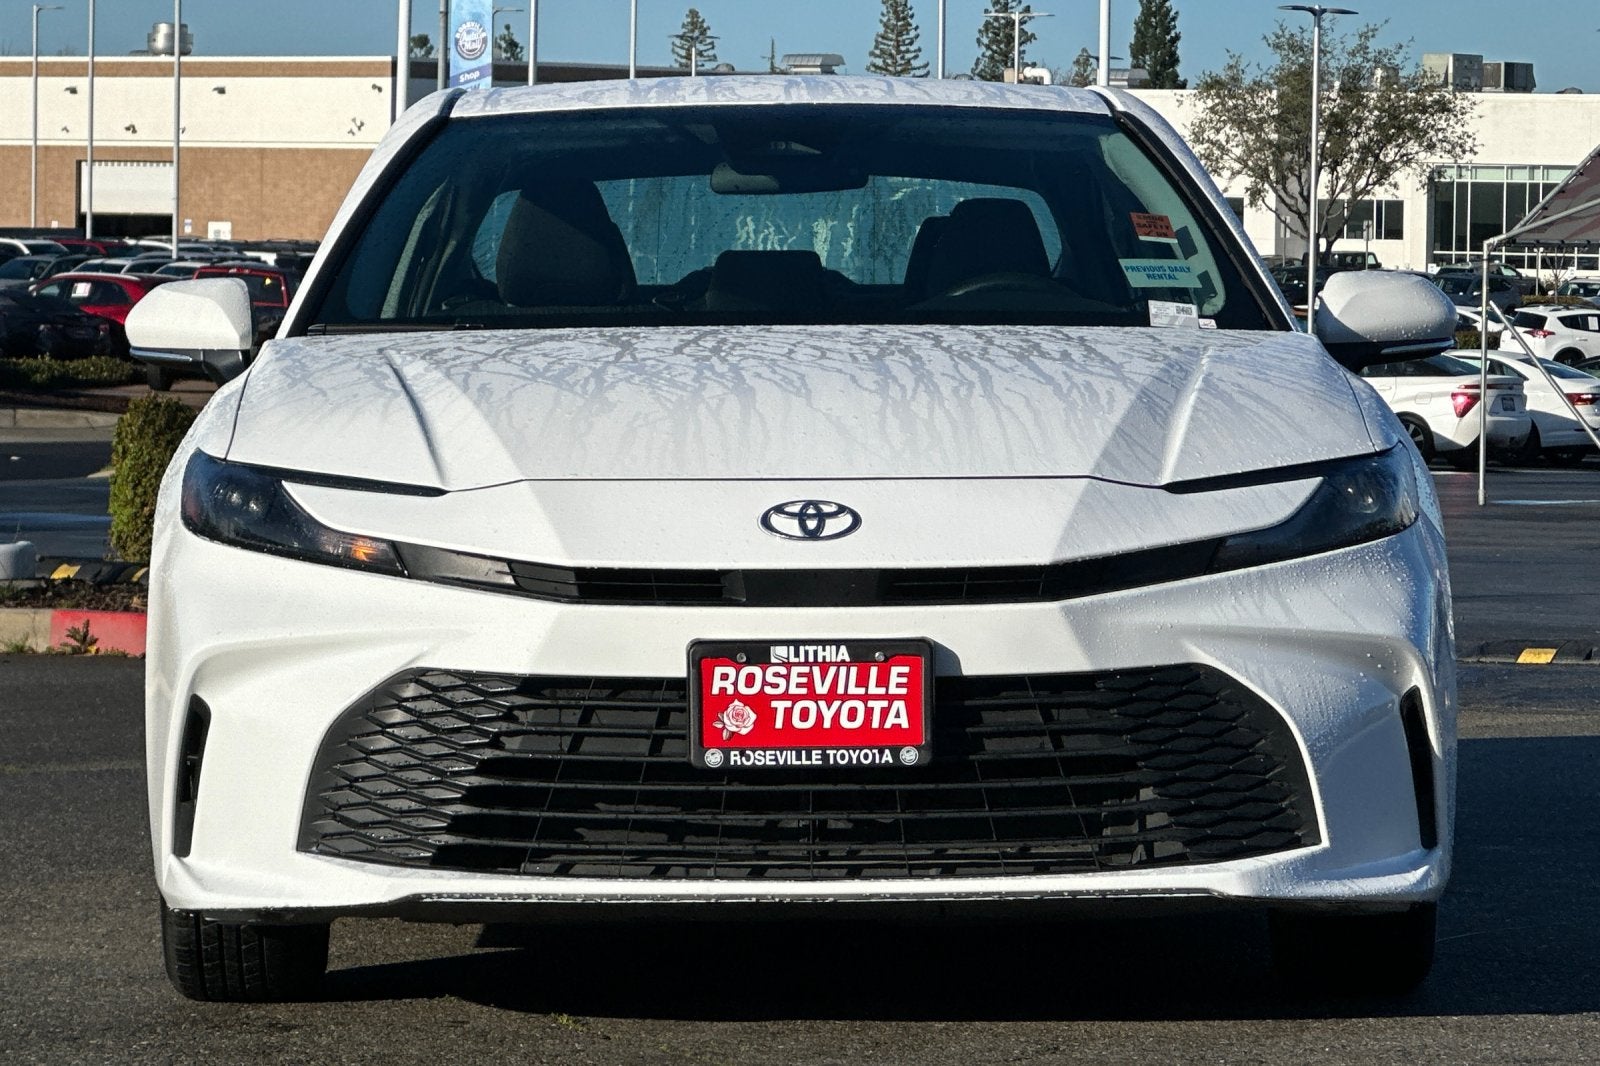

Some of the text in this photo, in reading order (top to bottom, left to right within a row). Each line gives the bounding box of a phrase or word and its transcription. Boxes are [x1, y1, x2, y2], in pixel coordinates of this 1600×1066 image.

[459, 70, 480, 83] Shop
[1168, 266, 1191, 274] DAILY
[788, 645, 850, 663] LITHIA
[711, 665, 910, 696] ROSEVILLE
[770, 699, 910, 730] TOYOTA
[730, 750, 822, 766] ROSEVILLE
[826, 749, 893, 765] TOYOTA
